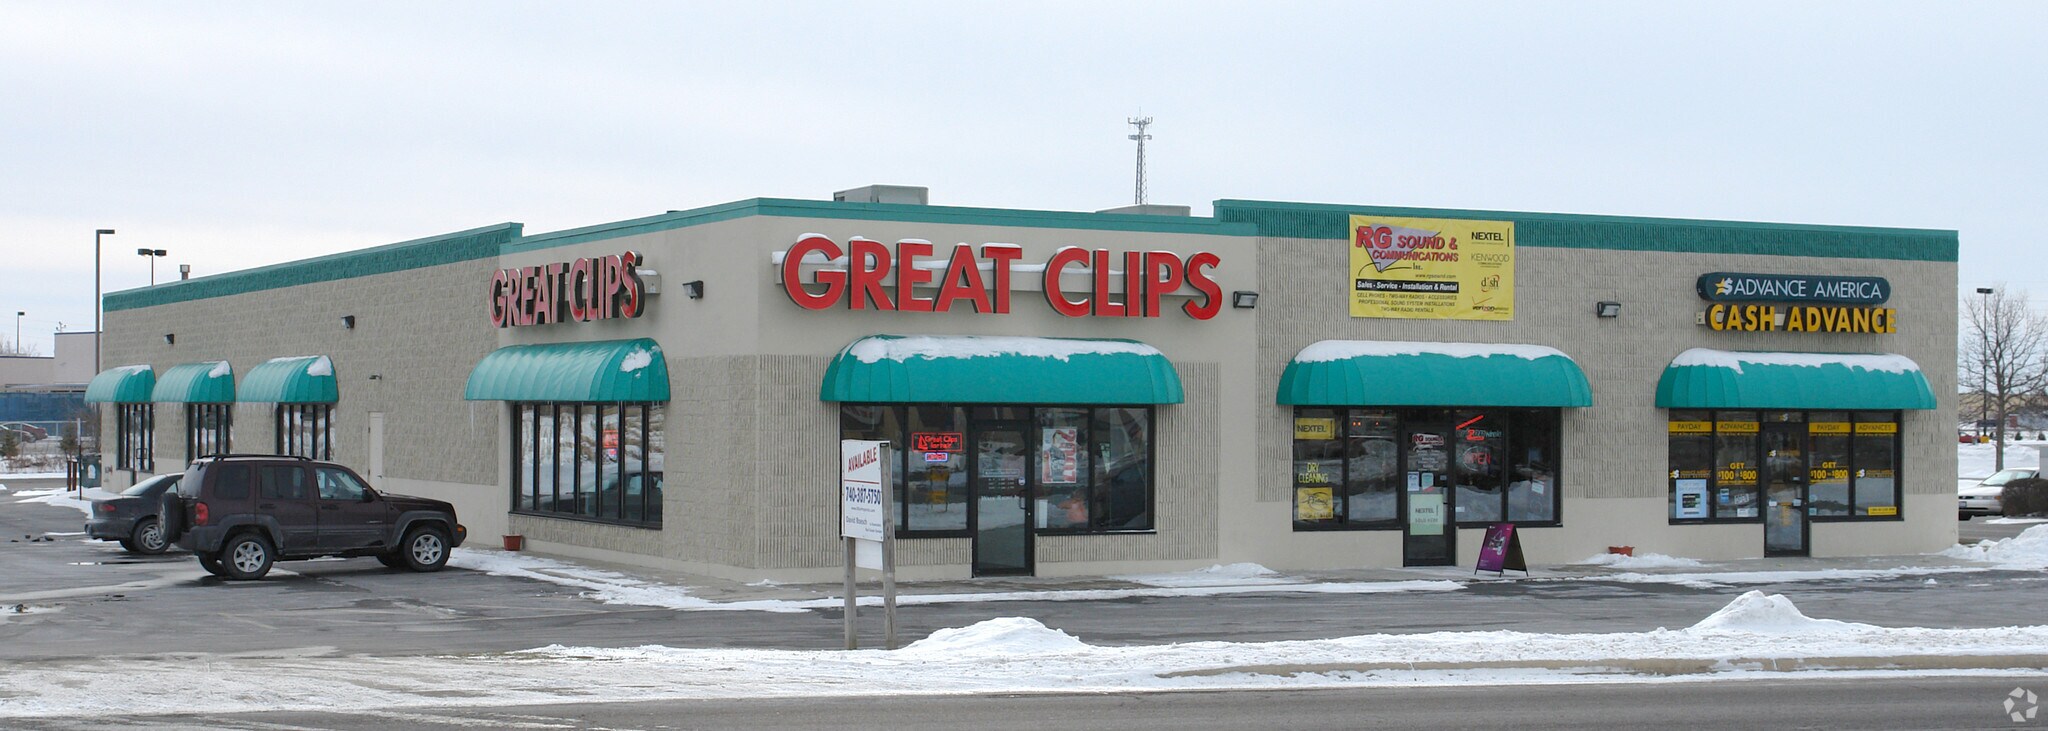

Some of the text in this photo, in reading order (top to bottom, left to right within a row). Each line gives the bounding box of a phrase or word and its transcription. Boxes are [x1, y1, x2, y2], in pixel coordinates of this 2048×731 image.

[1356, 226, 1458, 250] RG SOUND &
[1472, 232, 1504, 241] NEXTEL
[1372, 250, 1459, 262] COMMUNICATIONS
[1471, 253, 1509, 262] KENWOOD
[782, 235, 1222, 320] GREAT CLIPS
[489, 250, 644, 328] GREAT CLIPS
[1357, 280, 1372, 288] Sales
[1376, 282, 1398, 290] Service
[1402, 282, 1433, 291] Installation
[1734, 278, 1882, 299] ADVANCE AMERICA
[1707, 304, 1896, 334] CASH ADVANCE
[848, 447, 877, 472] AVAILABLE
[1464, 452, 1491, 464] OPEN
[1307, 462, 1319, 472] DRY
[1298, 473, 1328, 483] CLEANING
[1719, 471, 1734, 480] $100
[1811, 470, 1826, 478] $100
[846, 487, 880, 504] 740-387-5750
